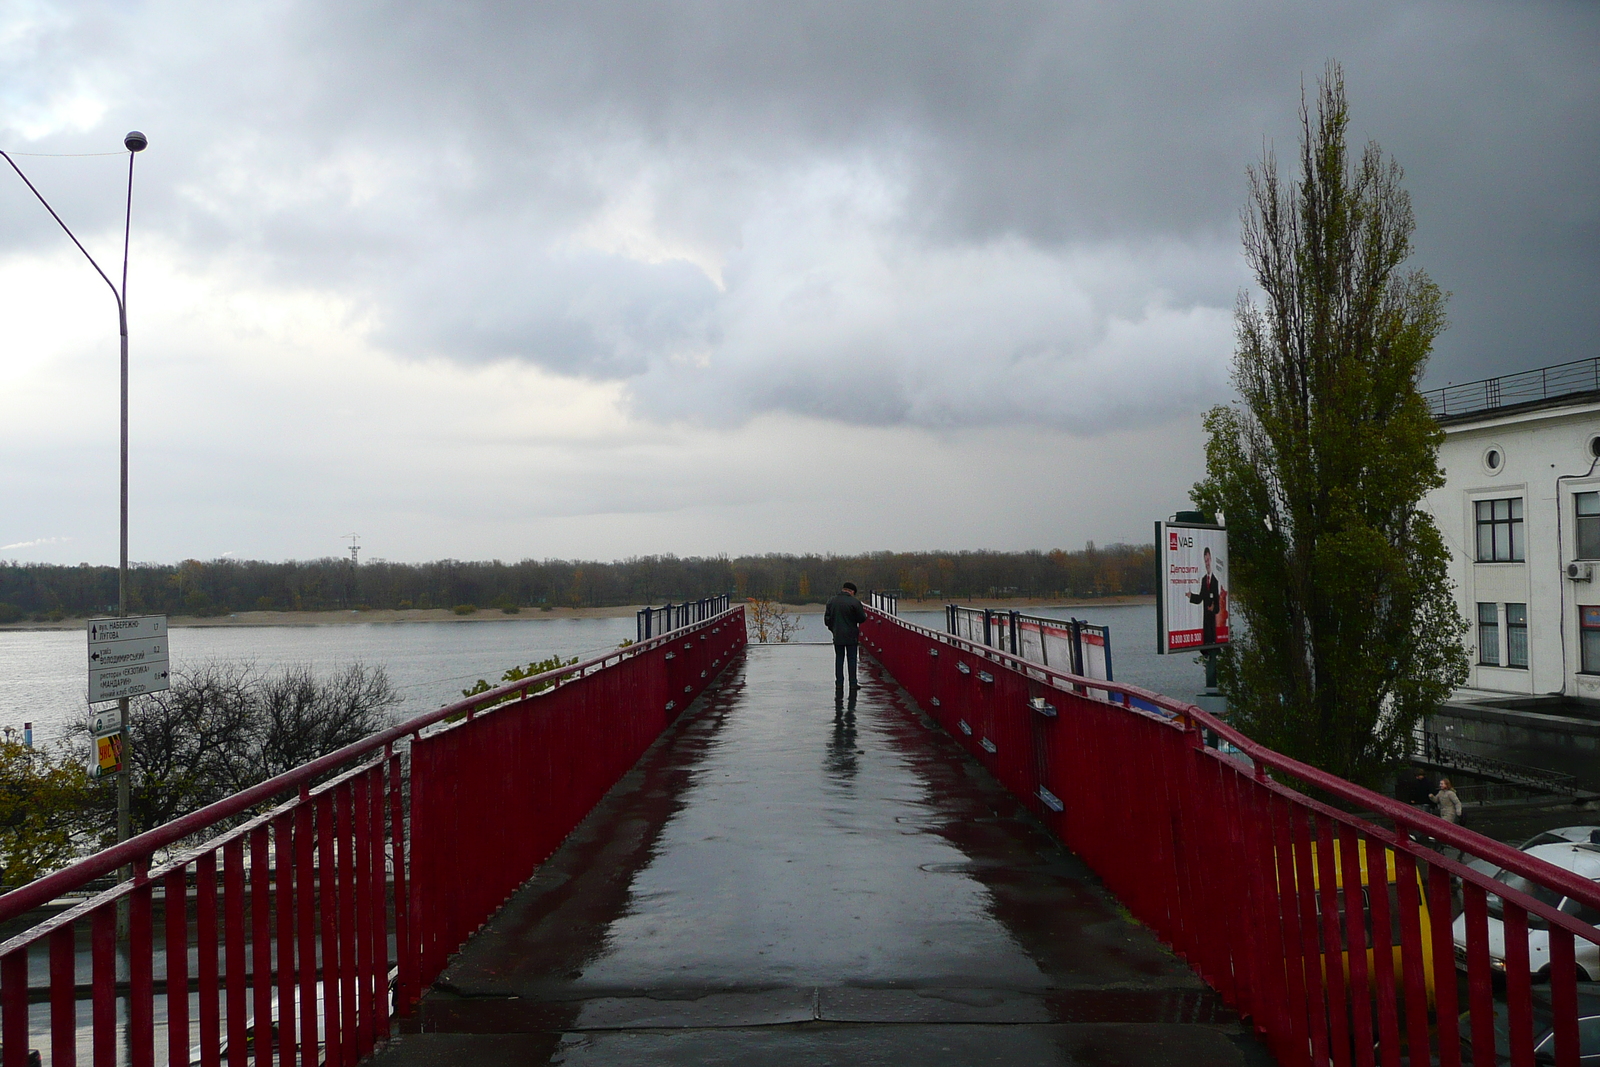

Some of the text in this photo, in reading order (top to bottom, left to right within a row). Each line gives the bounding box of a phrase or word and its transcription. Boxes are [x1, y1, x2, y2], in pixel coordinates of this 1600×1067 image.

[1178, 537, 1193, 548] VAB
[1170, 564, 1199, 574] Депозити
[109, 620, 140, 630] НАБЕРЕЖНО-
[99, 631, 119, 640] ЛУГОВА
[100, 650, 145, 665] ВОЛОДИМИРСЬКИЙ
[100, 672, 121, 681] ресторан
